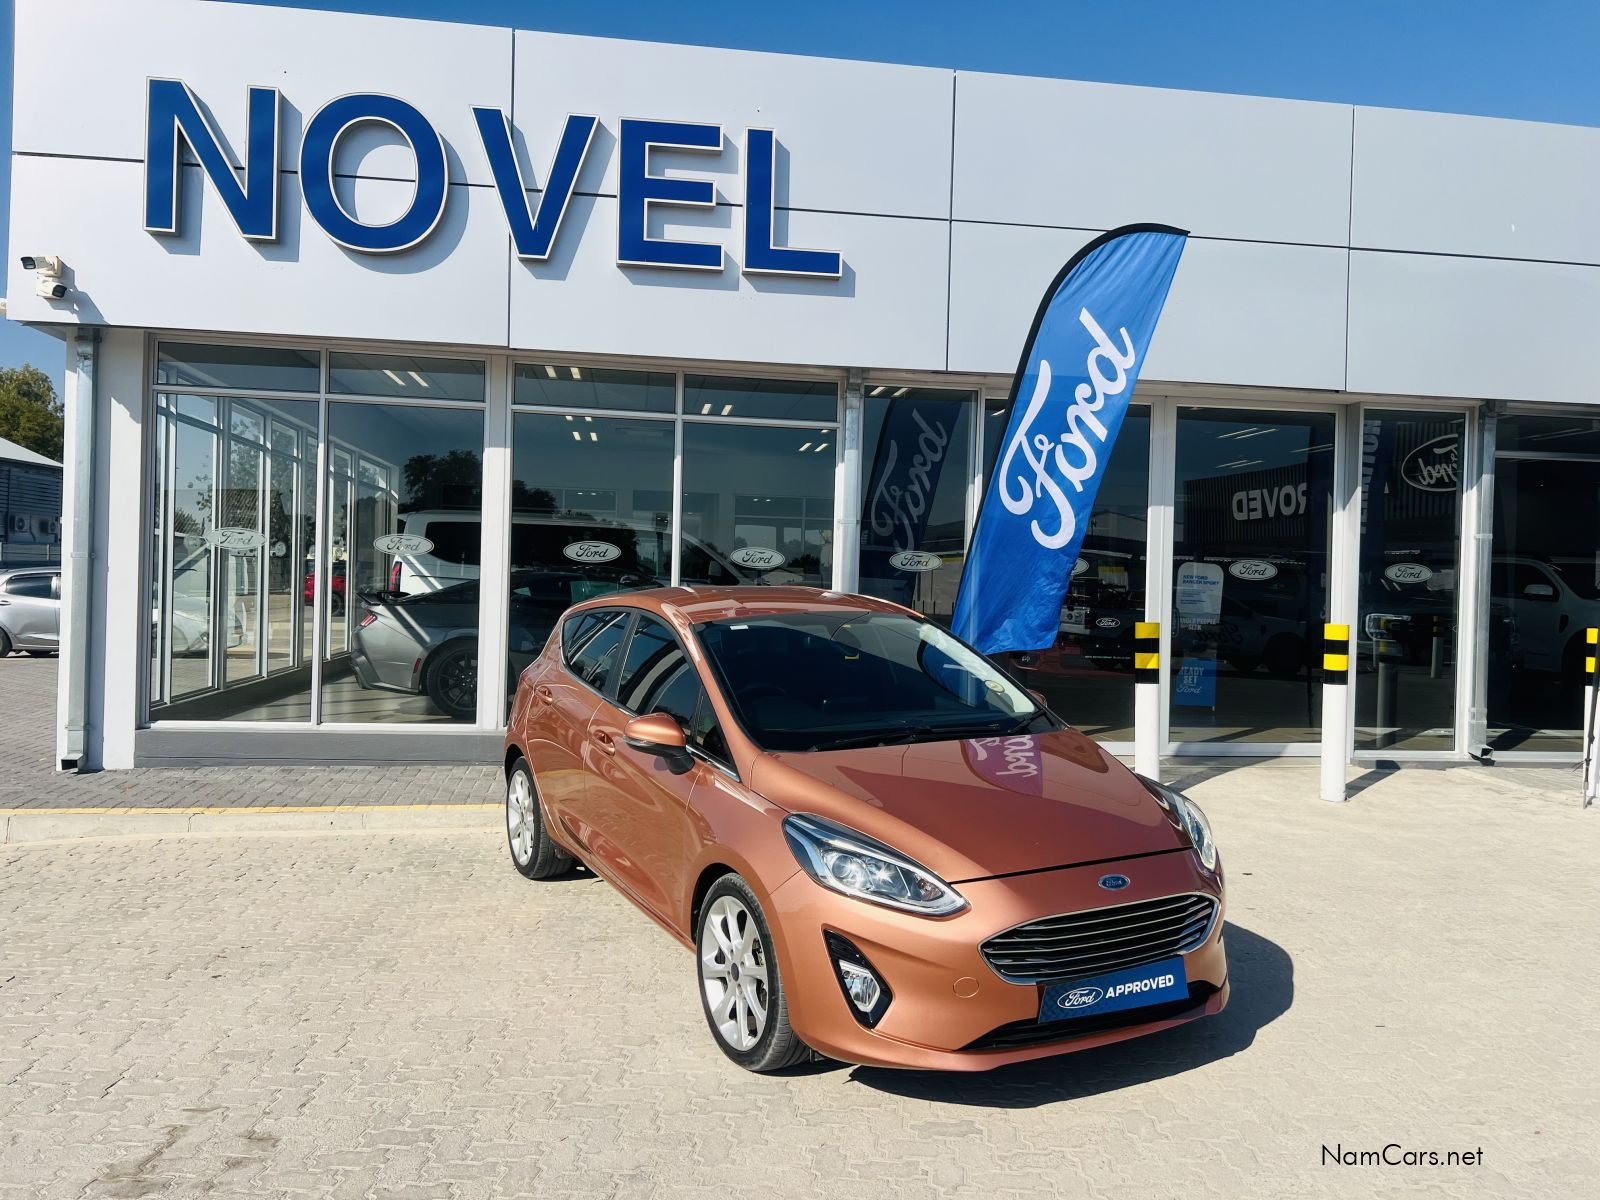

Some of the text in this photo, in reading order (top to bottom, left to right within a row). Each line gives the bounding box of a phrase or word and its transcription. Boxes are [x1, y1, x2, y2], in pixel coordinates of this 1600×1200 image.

[143, 76, 843, 278] NOVEL
[998, 307, 1136, 549] Ford
[386, 536, 421, 551] Ford
[576, 543, 609, 558] Ford
[742, 550, 773, 564] Ford
[900, 554, 931, 567] Ford
[1239, 562, 1268, 576] Ford
[1394, 566, 1423, 579] Ford
[1064, 974, 1175, 1007] Ford APPROVED
